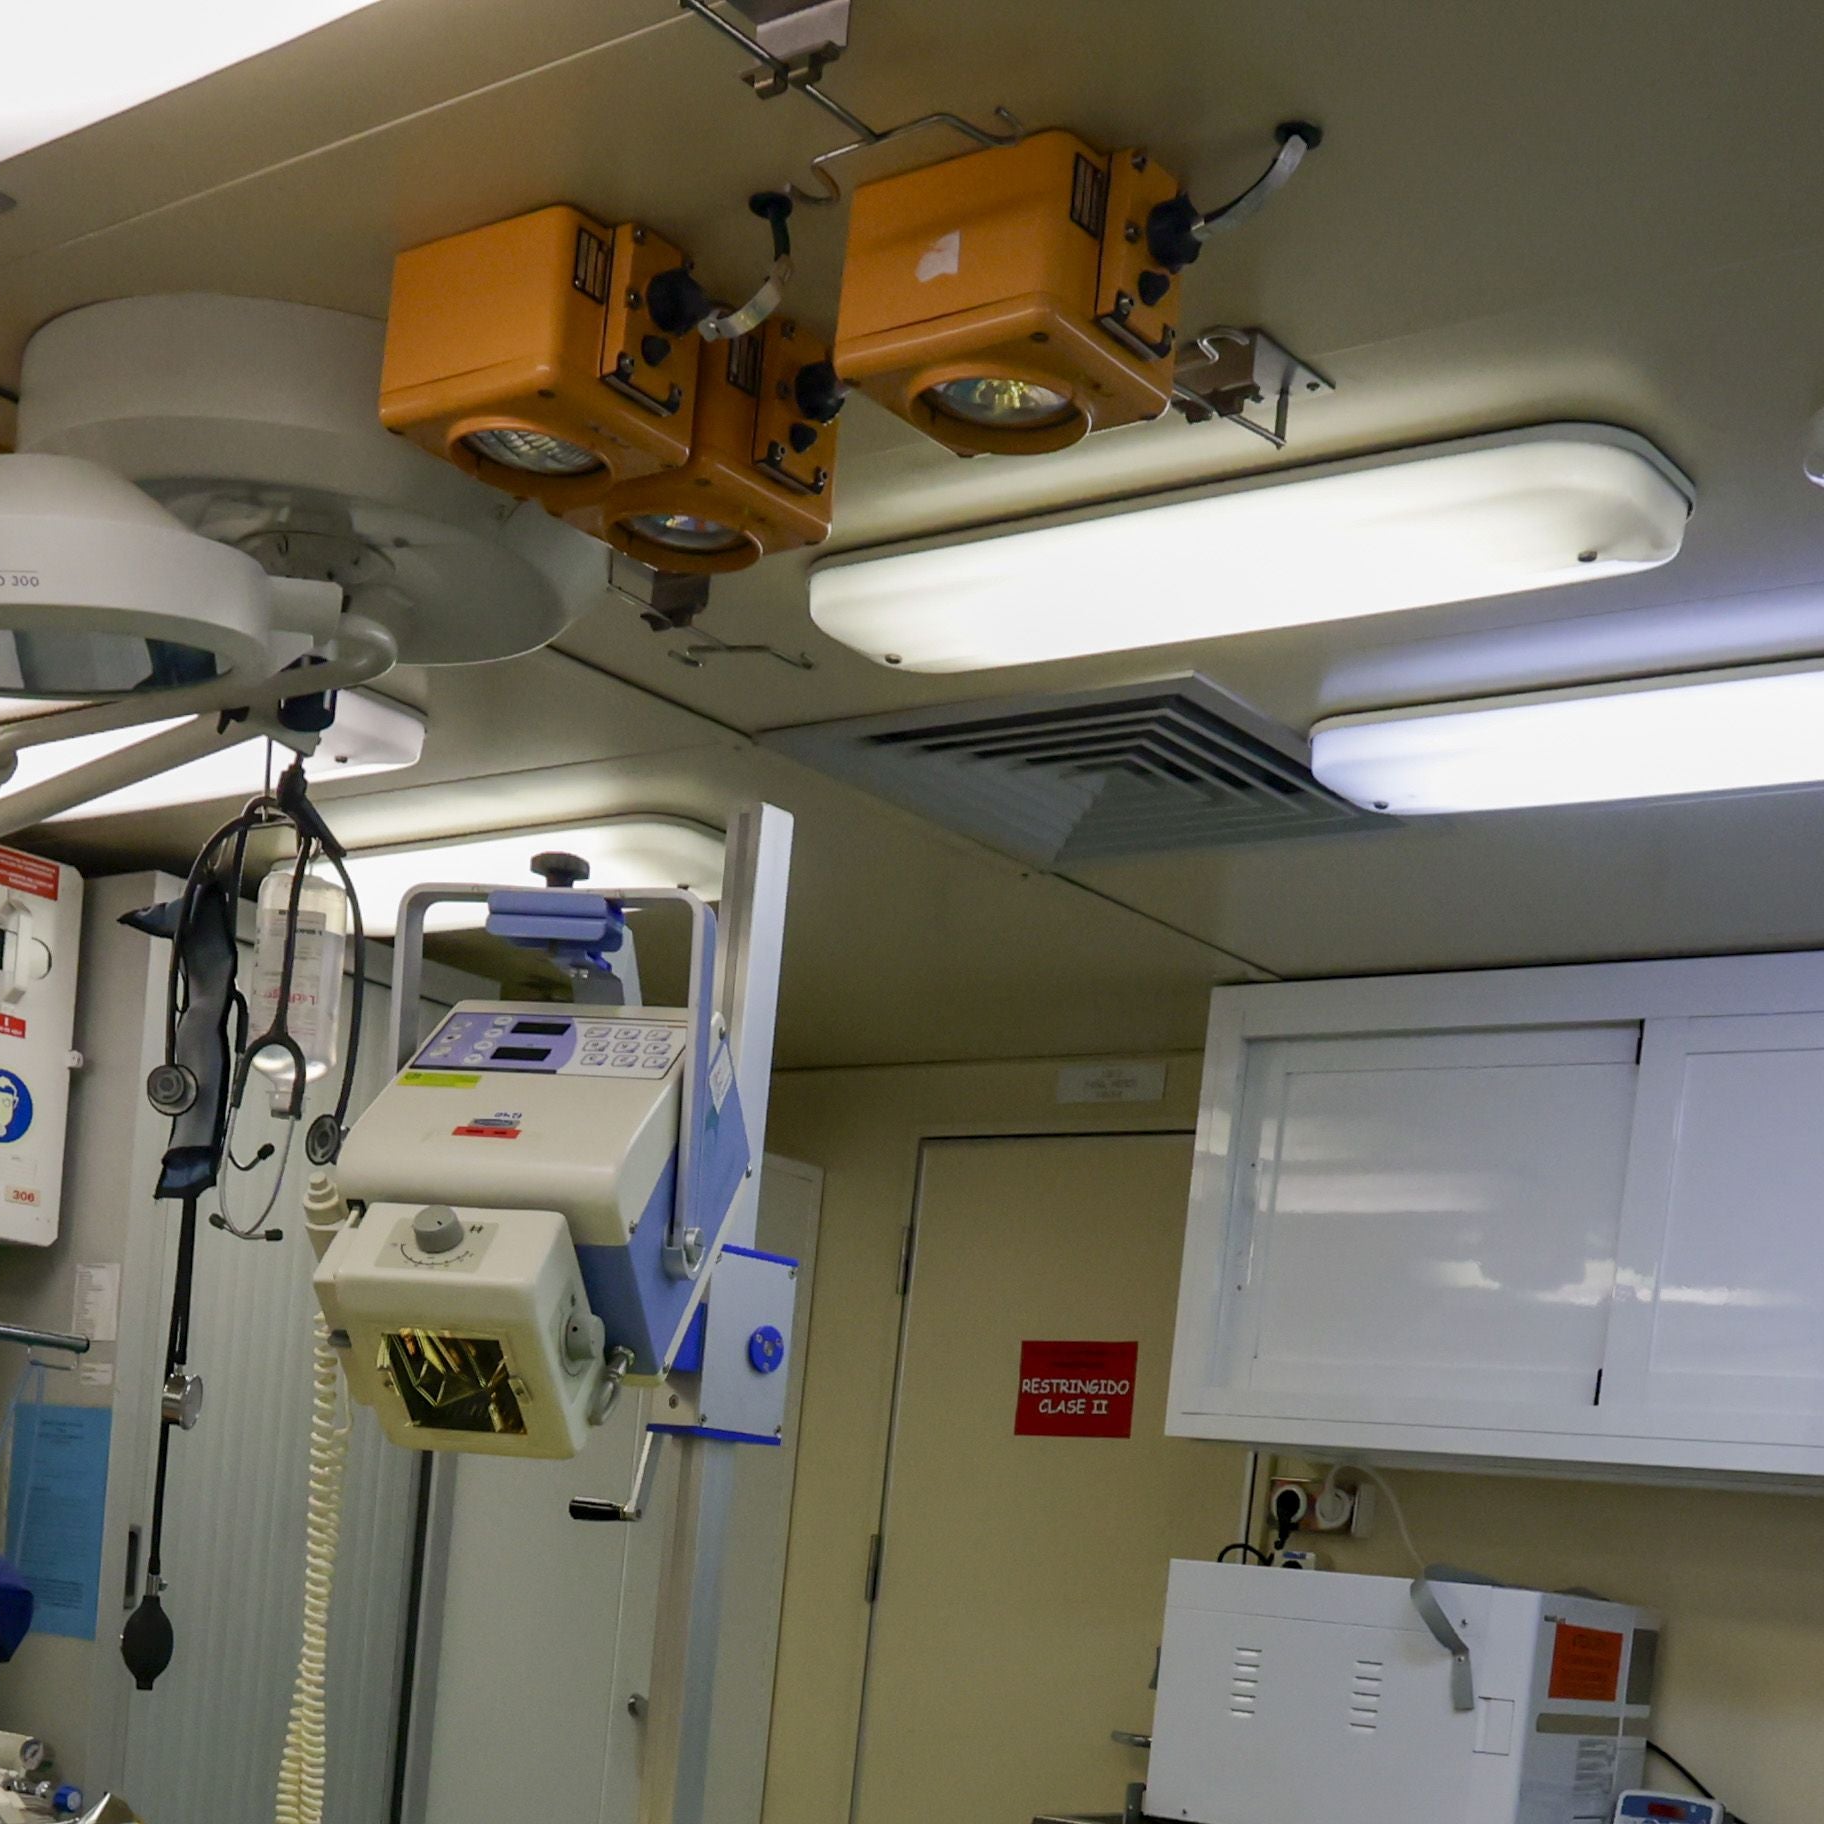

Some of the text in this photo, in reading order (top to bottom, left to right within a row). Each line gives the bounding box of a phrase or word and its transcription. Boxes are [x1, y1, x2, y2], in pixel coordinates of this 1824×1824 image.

[1021, 1378, 1130, 1395] RESTRINGIDO
[1038, 1398, 1109, 1415] CLASE II
